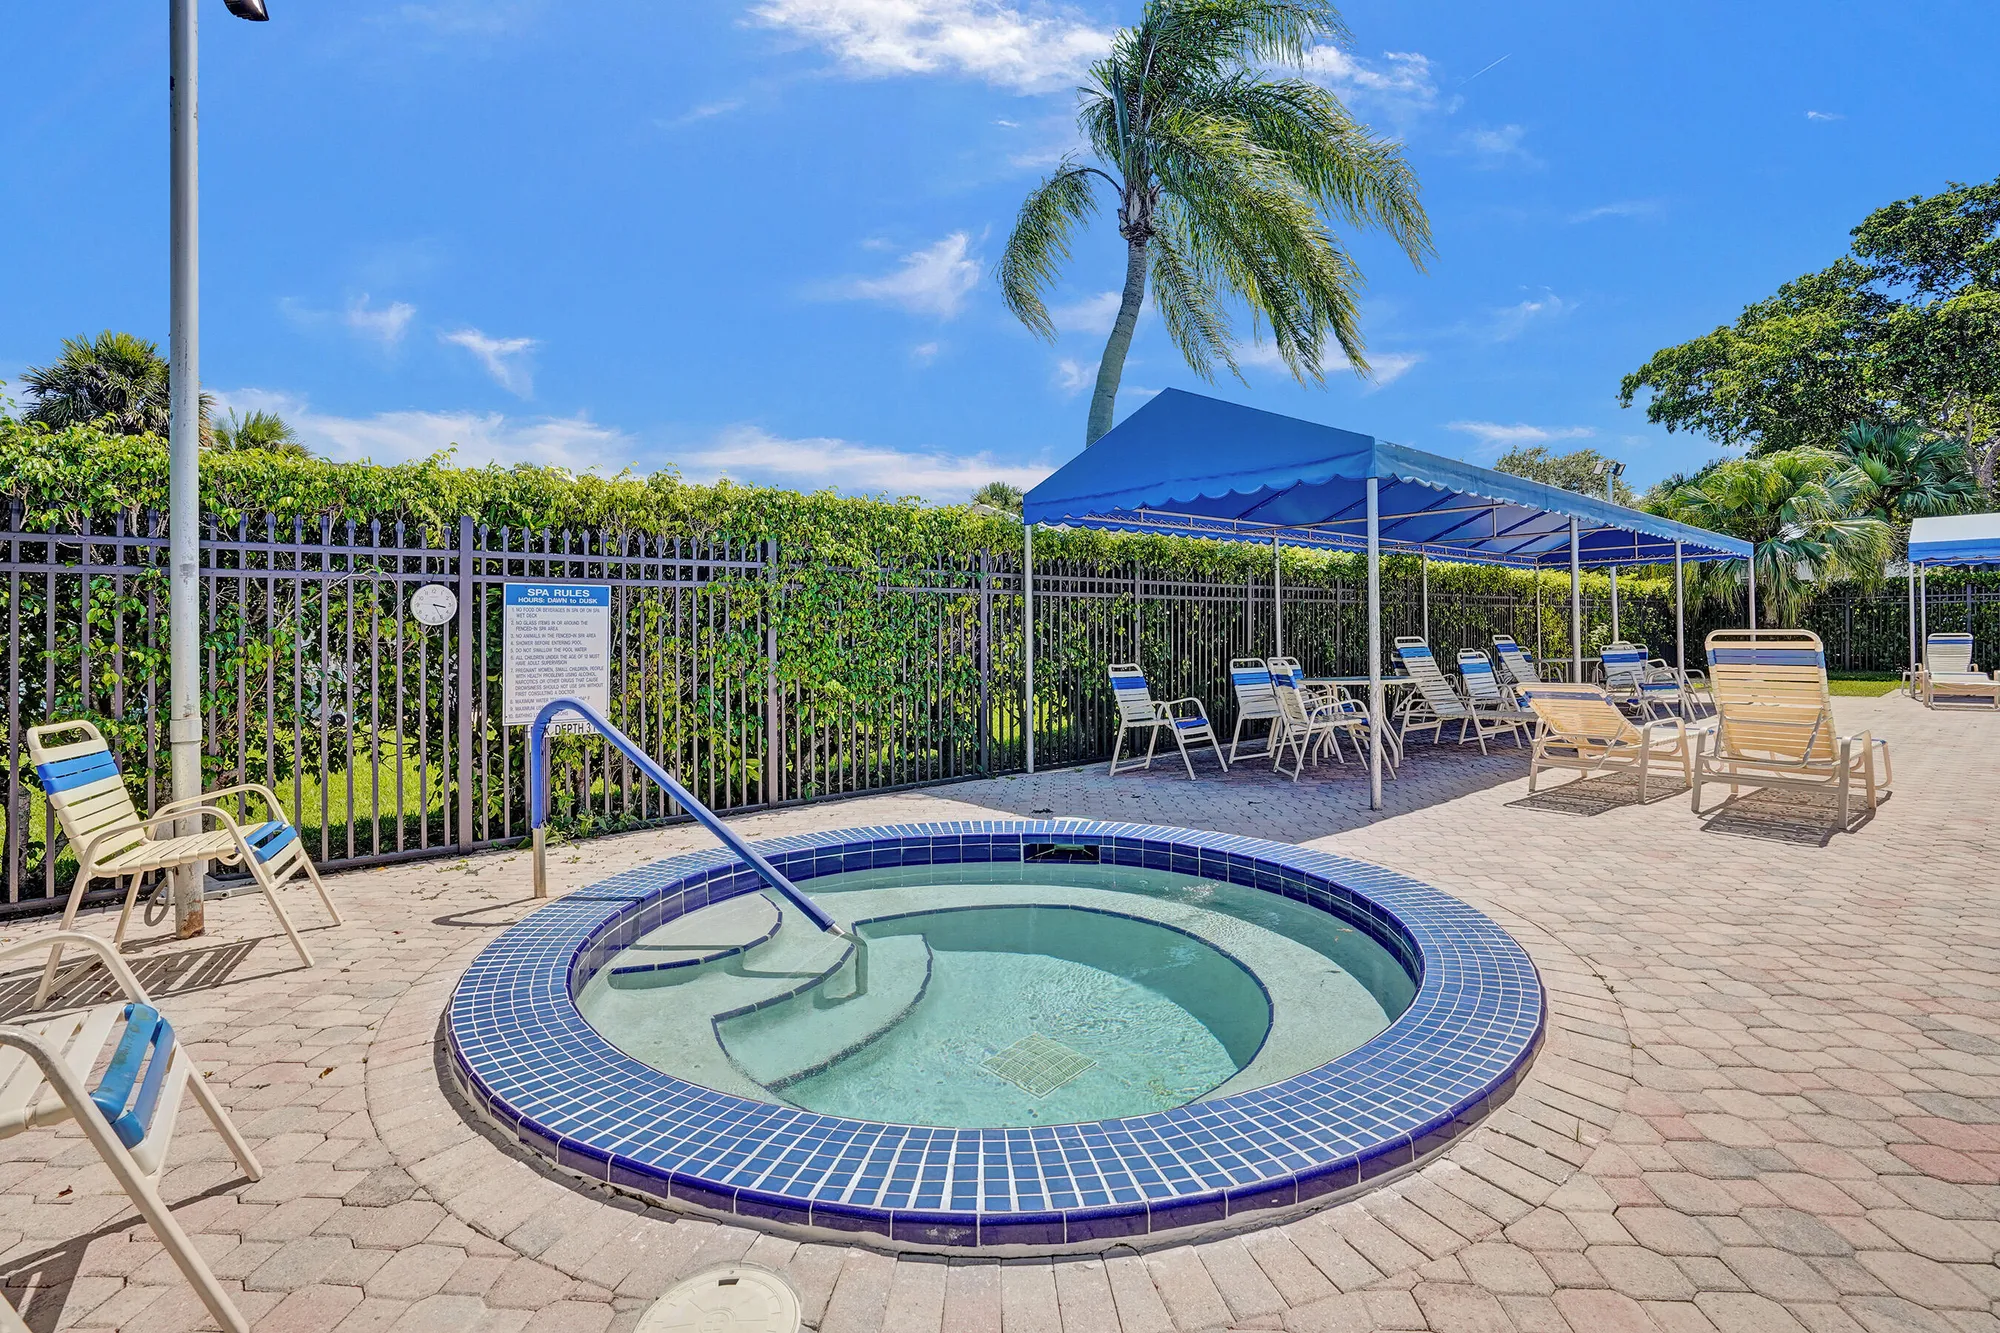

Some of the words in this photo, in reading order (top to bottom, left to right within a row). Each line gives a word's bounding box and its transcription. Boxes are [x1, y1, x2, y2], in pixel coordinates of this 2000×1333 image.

[527, 588, 550, 597] SPA
[554, 589, 590, 597] RULES
[554, 723, 584, 736] DEPTH
